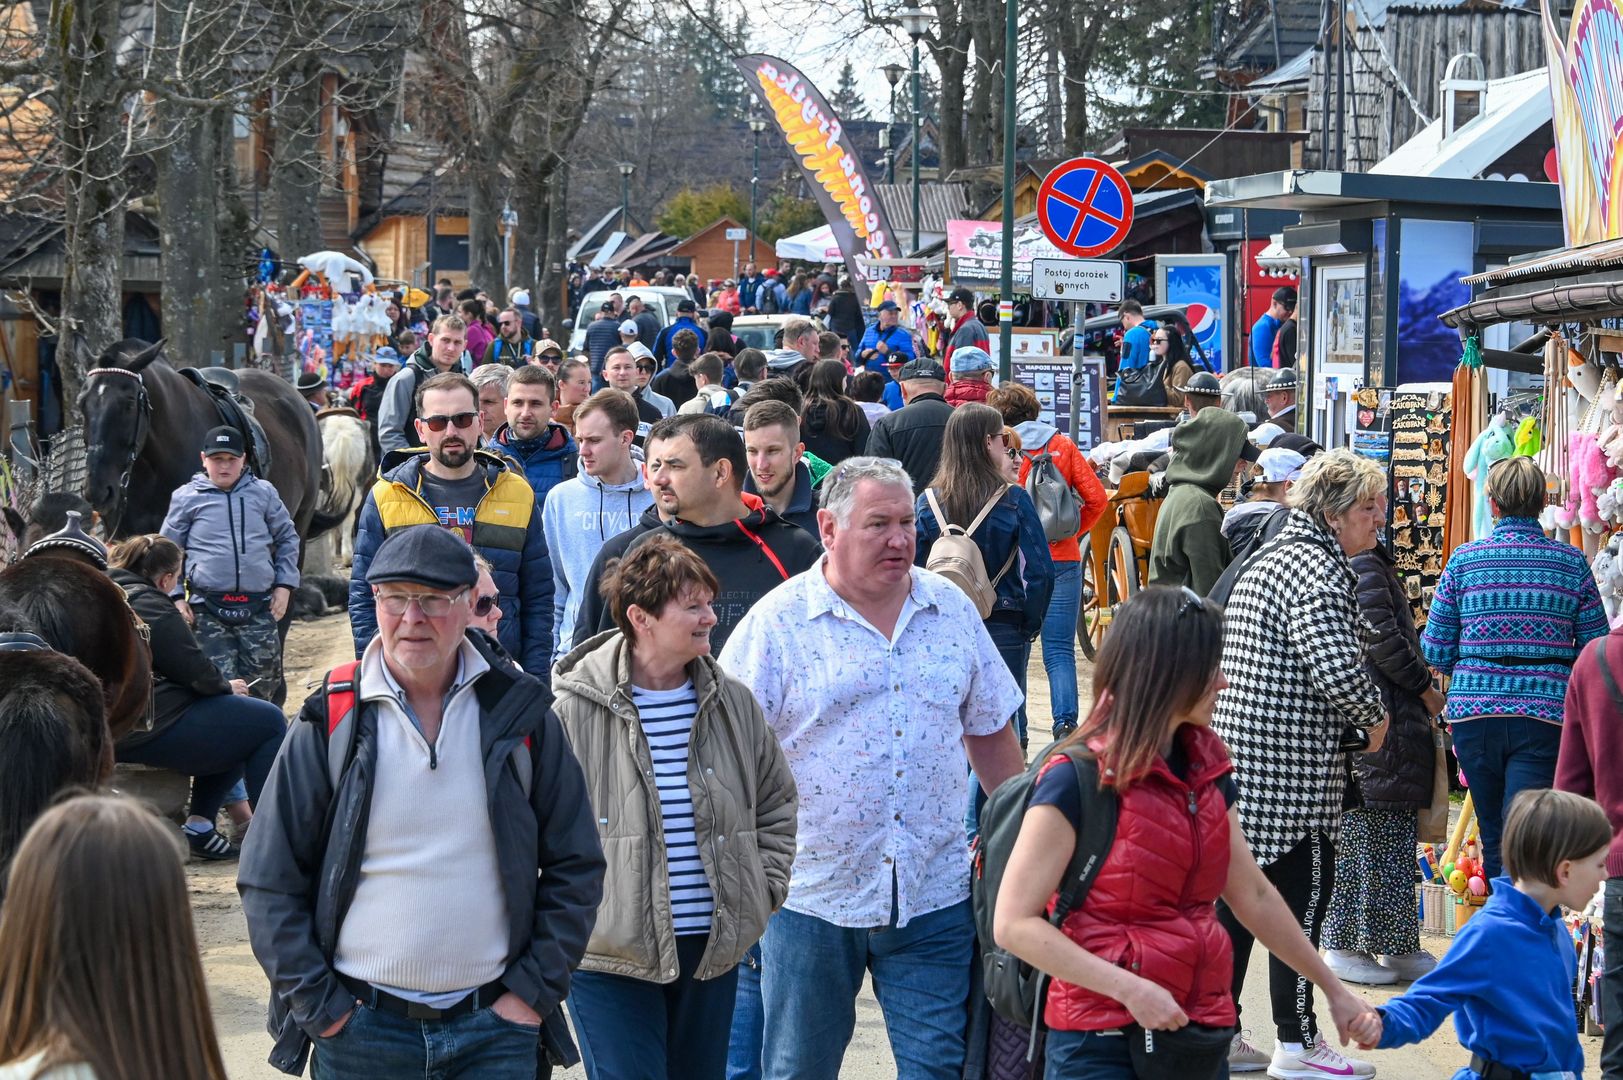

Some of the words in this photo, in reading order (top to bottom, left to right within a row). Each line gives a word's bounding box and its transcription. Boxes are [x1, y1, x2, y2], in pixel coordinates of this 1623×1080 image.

[1074, 269, 1109, 279] dorożek
[1392, 400, 1426, 410] ZAKOPANE
[1392, 420, 1426, 429] ZAKOPANE
[223, 594, 248, 603] Audi
[1296, 973, 1307, 993] ONG
